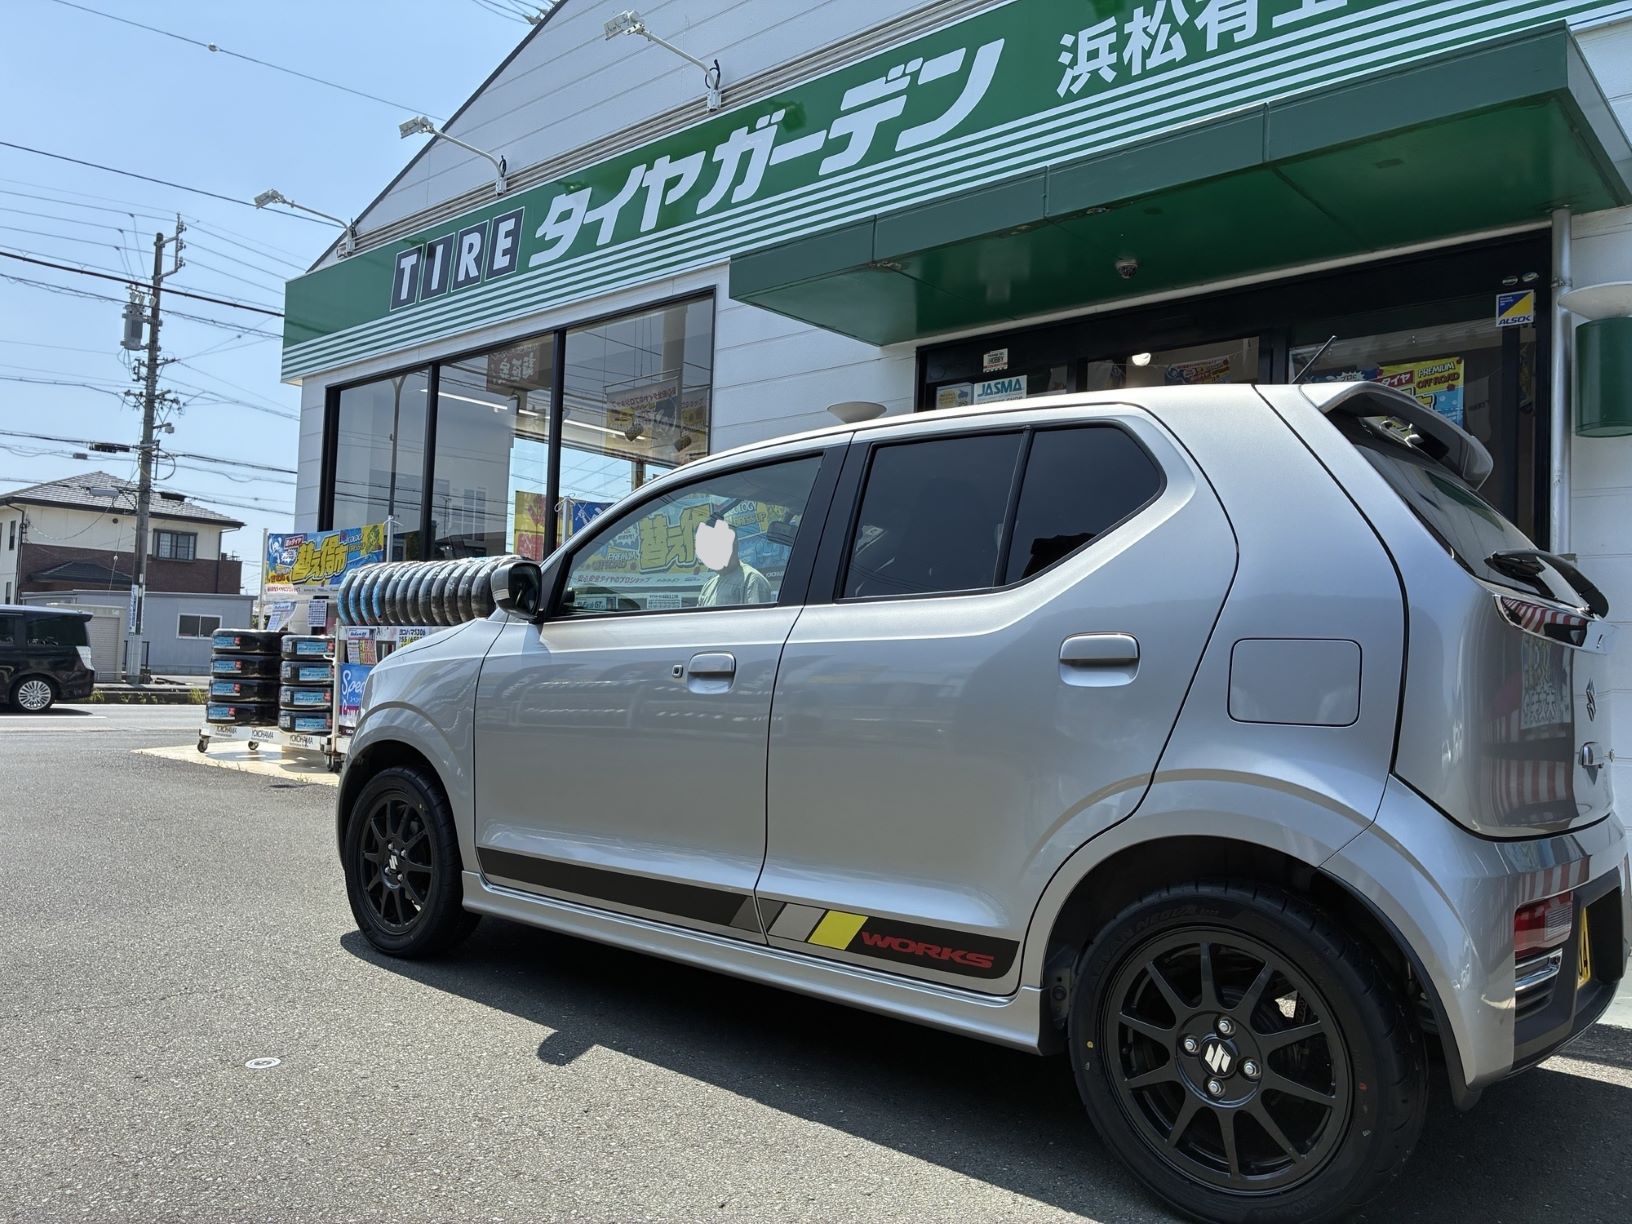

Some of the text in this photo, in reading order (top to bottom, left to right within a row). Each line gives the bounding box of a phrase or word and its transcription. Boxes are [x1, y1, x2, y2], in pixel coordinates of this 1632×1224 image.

[399, 230, 518, 303] TIRE
[528, 38, 1005, 268] タイヤガーデン
[1498, 314, 1532, 326] ALSOK
[1417, 362, 1457, 378] PREMIUM
[977, 378, 1022, 397] JASMA
[862, 931, 994, 969] WORKS
